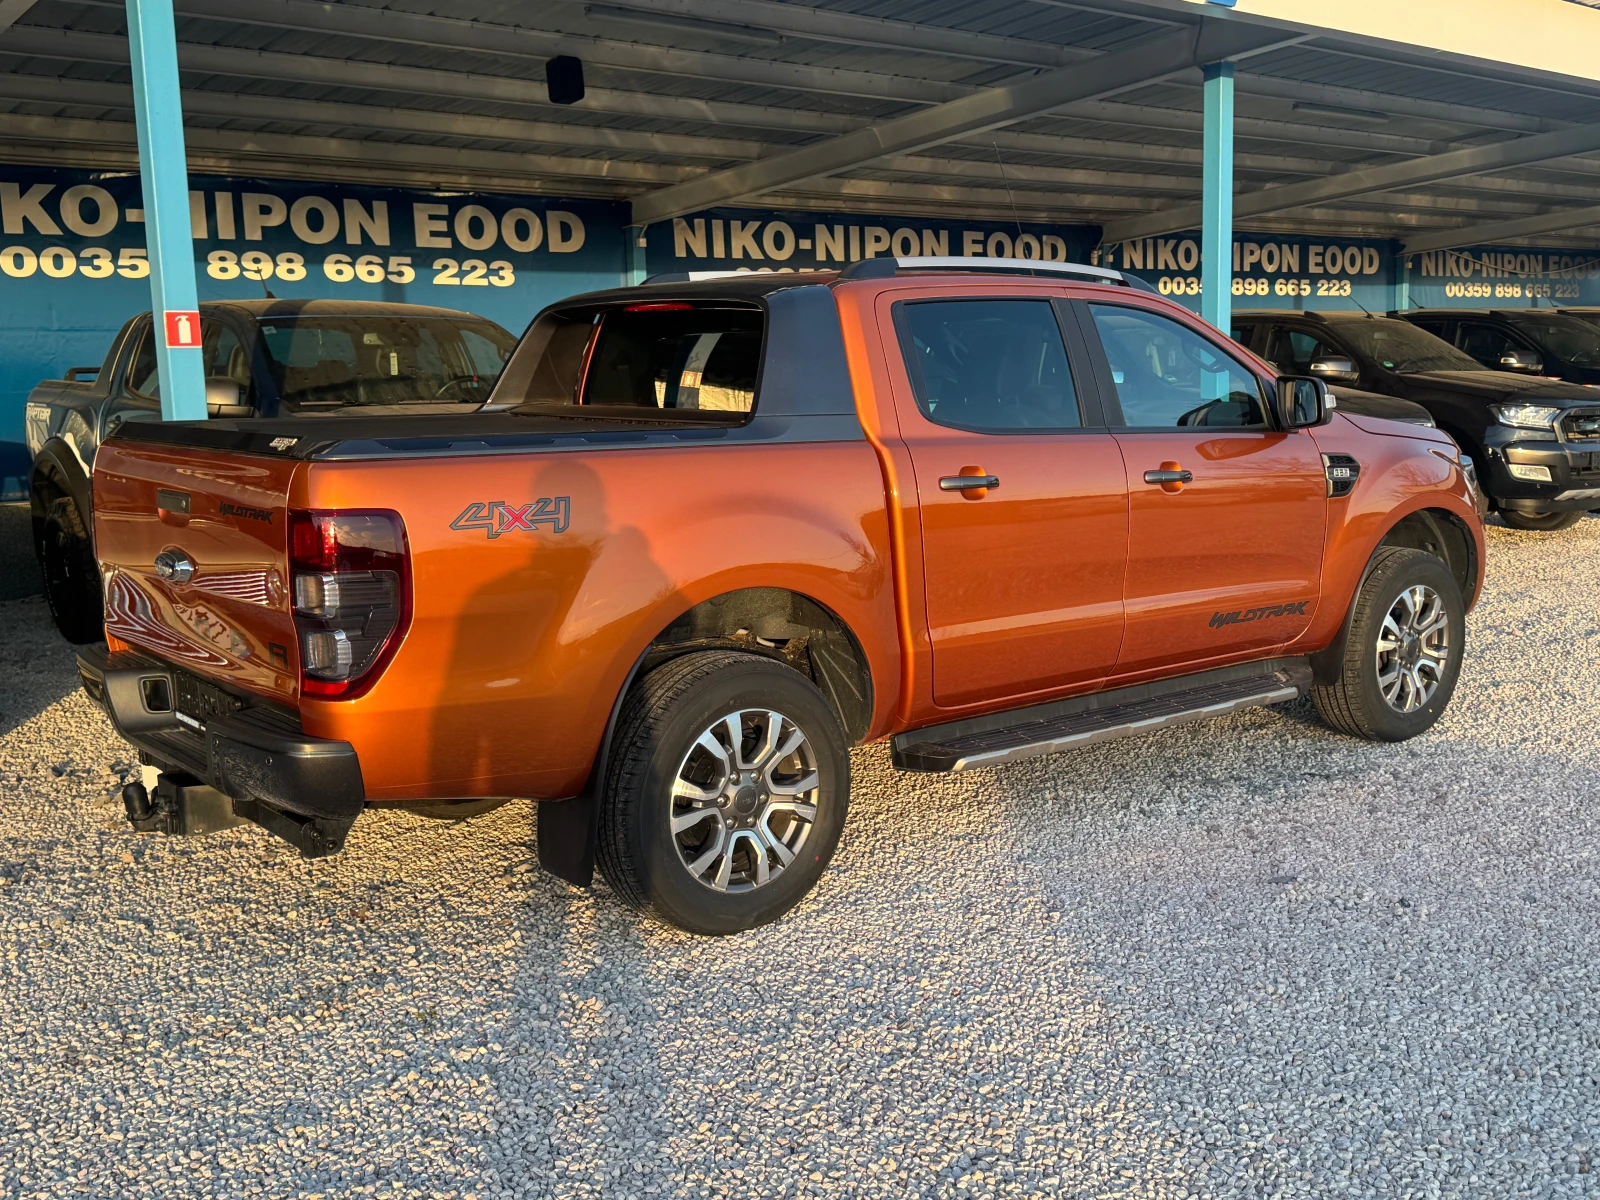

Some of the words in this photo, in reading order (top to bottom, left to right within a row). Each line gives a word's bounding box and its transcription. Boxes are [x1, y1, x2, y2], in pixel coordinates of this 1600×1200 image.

[413, 202, 586, 253] EOOD
[672, 218, 949, 262] NIKO-NIPON
[963, 231, 1067, 262] EOOD
[0, 246, 151, 279] 0035
[207, 250, 307, 281] 898
[323, 253, 416, 284] 665
[432, 258, 516, 287] 223
[1122, 239, 1299, 273] NIKOIPON
[1308, 245, 1380, 275] EOOD
[1421, 250, 1543, 279] NIKO-NIPON
[1549, 255, 1600, 280] EOOD
[1158, 276, 1203, 296] 003
[1231, 278, 1269, 296] 898
[1274, 279, 1312, 297] 665
[1316, 279, 1352, 297] 223
[1445, 282, 1492, 298] 00359
[1494, 282, 1522, 298] 898
[1525, 283, 1551, 298] 665
[1554, 283, 1580, 298] 223
[219, 501, 274, 525] WILDTRAK
[1208, 601, 1310, 629] WILDTRAK
